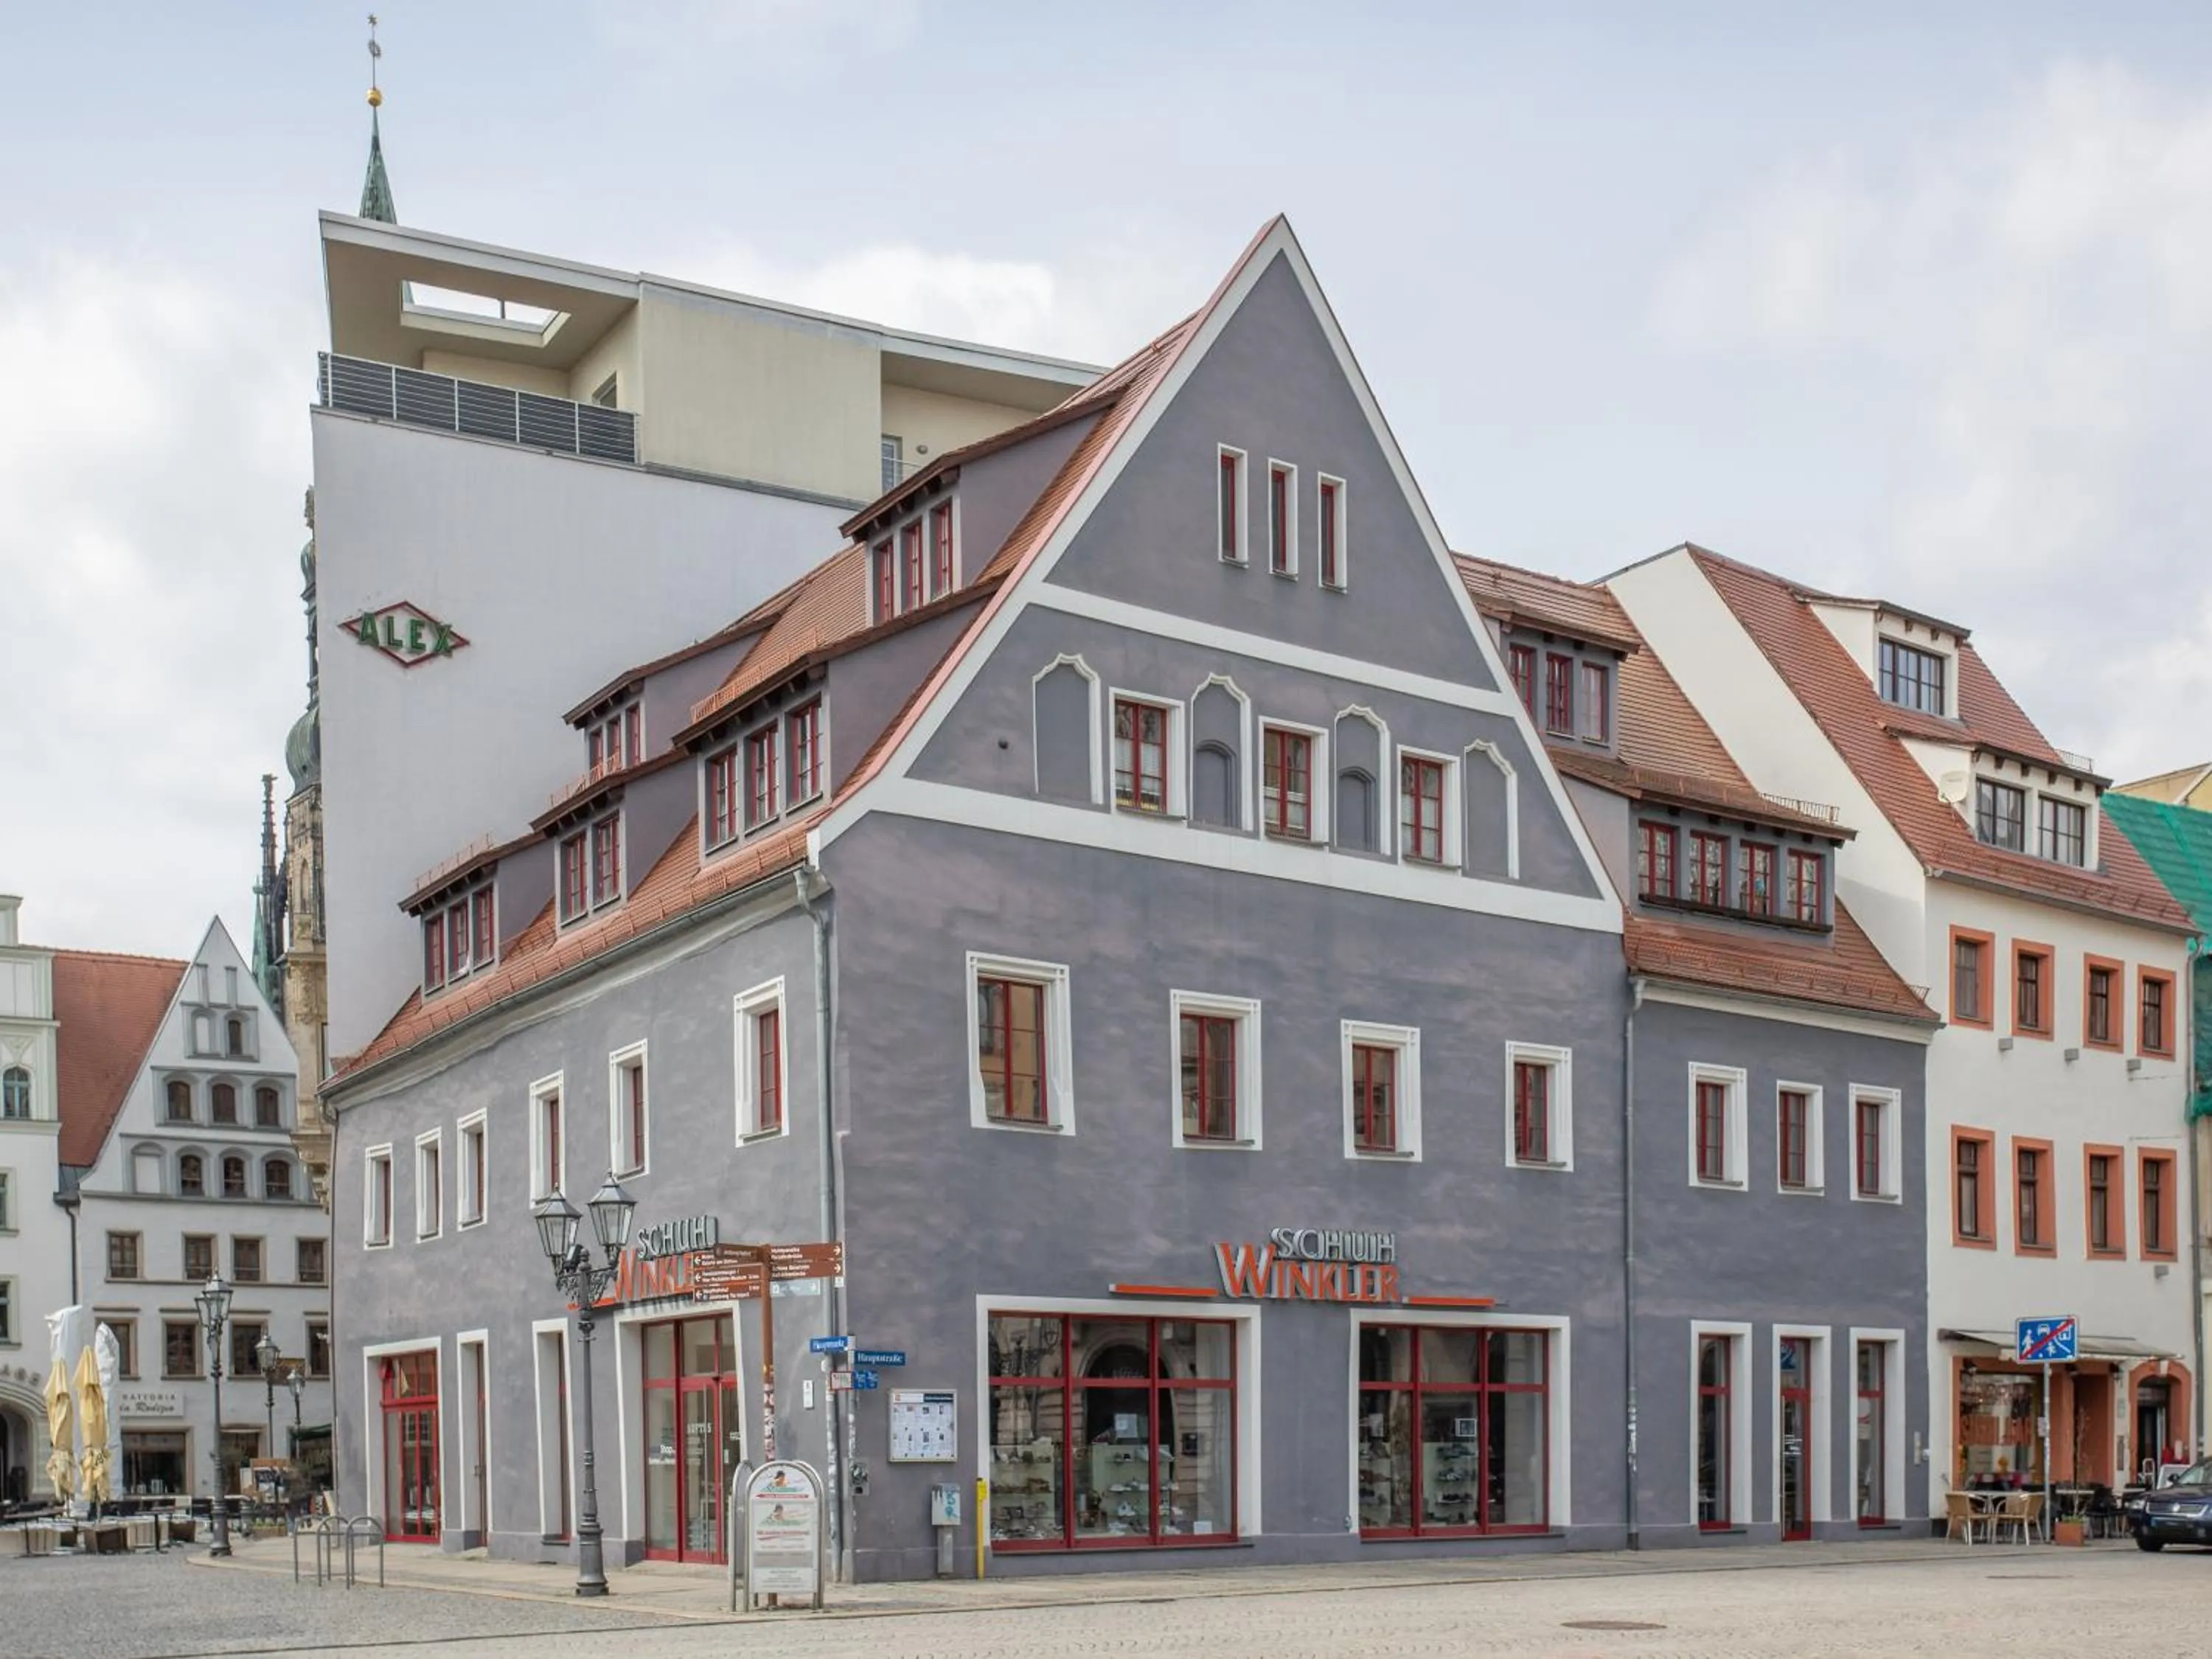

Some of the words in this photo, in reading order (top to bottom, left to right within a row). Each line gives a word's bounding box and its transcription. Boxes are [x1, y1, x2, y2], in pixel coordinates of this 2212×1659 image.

[360, 611, 452, 655] ALEX
[637, 1215, 717, 1259] SCHUH
[1270, 1227, 1395, 1262] SCHUH
[613, 1248, 693, 1301] WINKLE
[1214, 1241, 1399, 1302] WINKLER
